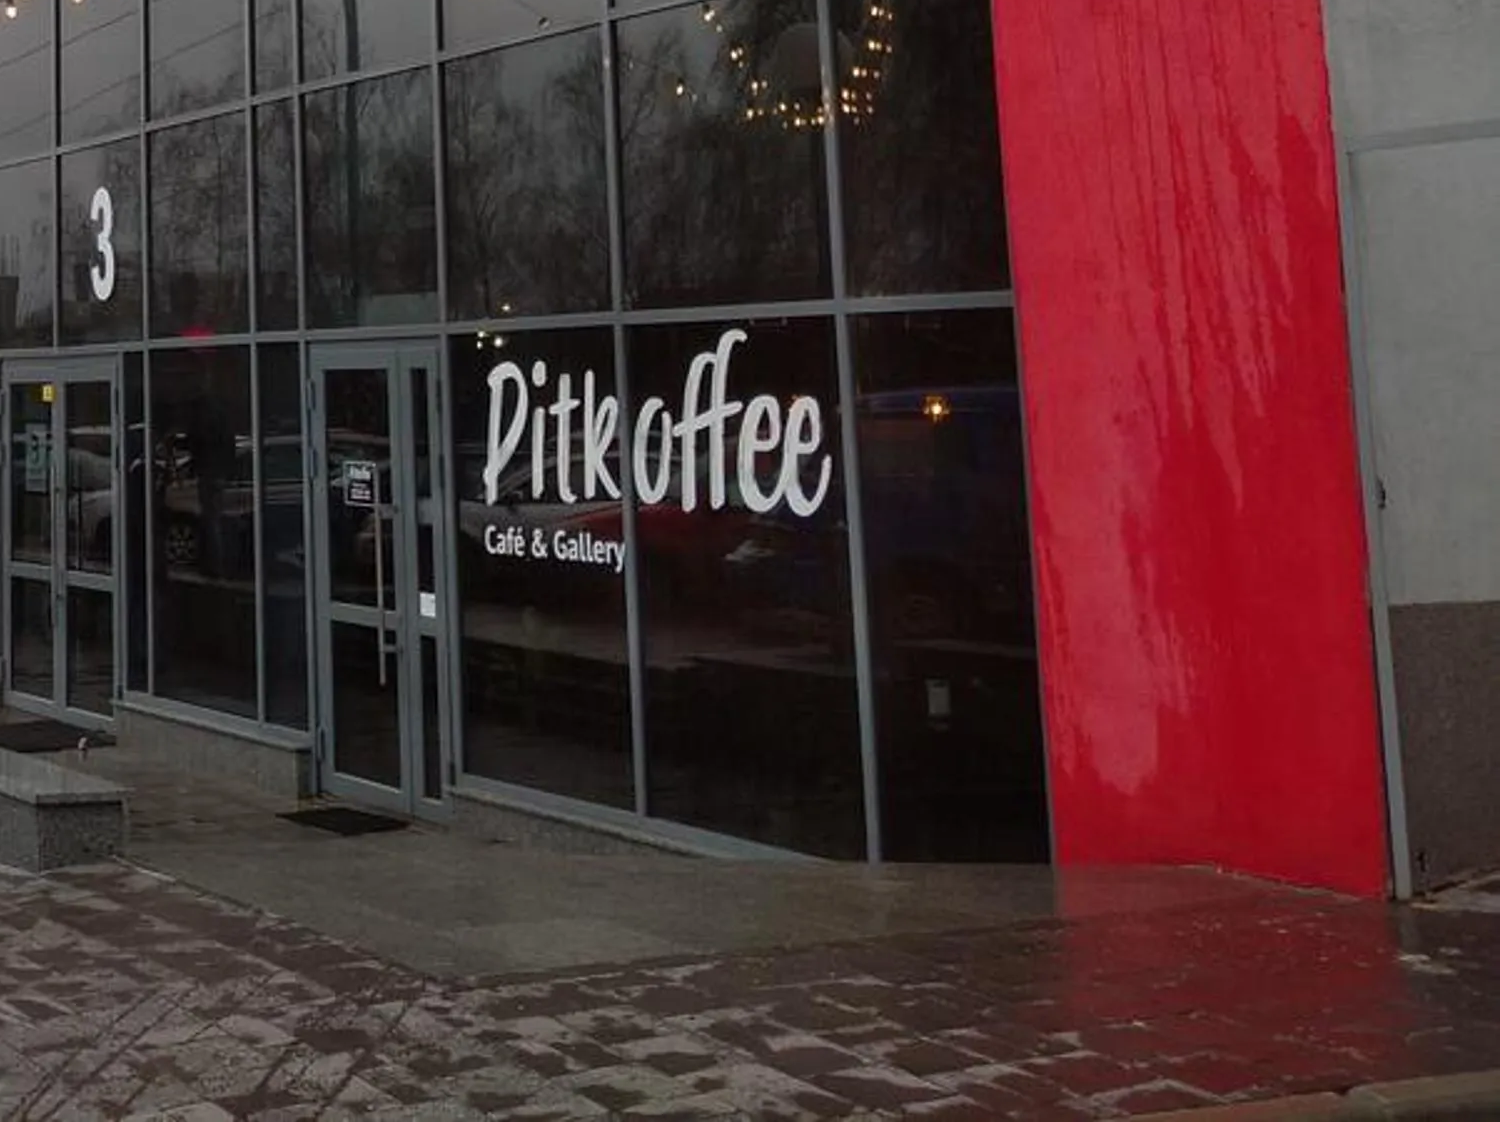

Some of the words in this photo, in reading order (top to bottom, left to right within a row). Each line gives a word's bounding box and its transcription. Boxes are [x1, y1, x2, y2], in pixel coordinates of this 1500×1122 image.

[90, 186, 115, 300] 3
[483, 329, 832, 517] Pitkoffee
[484, 525, 525, 557] Café
[531, 528, 548, 558] &
[553, 530, 625, 574] Gallery
